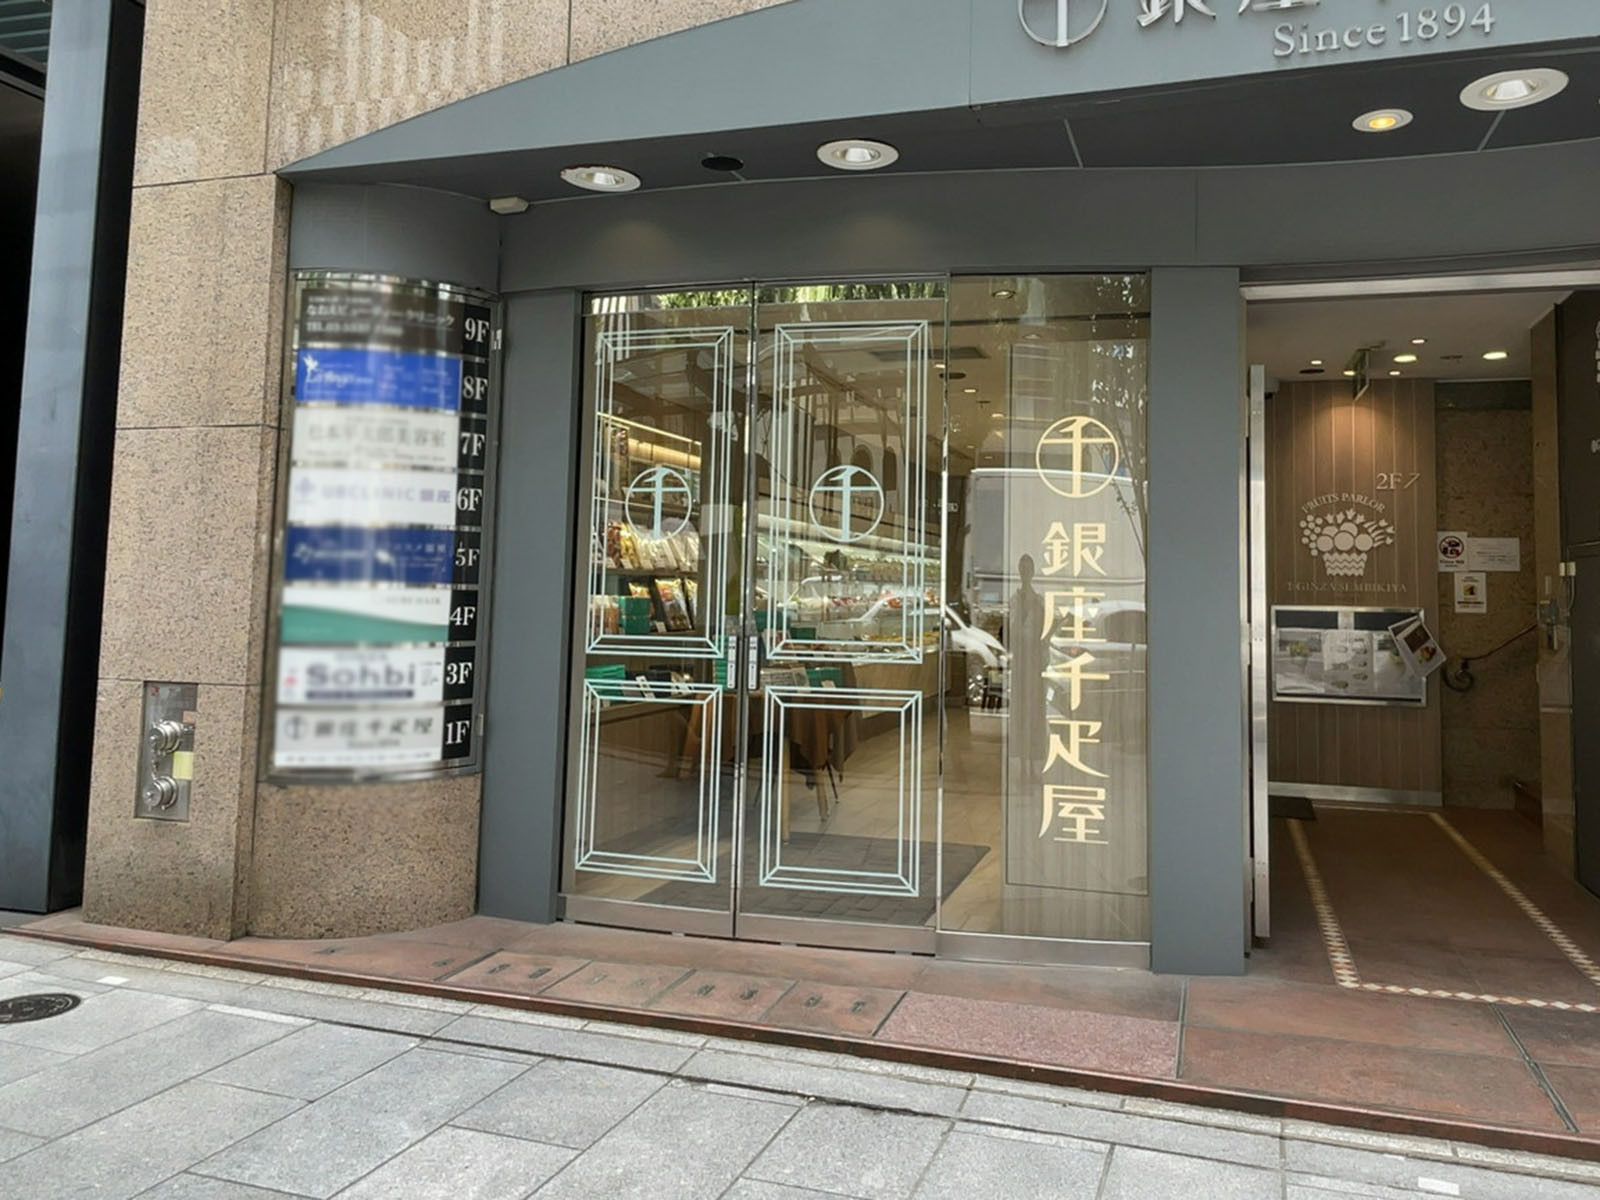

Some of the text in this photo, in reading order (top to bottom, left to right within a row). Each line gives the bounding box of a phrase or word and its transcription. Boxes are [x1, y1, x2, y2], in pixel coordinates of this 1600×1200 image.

[1273, 2, 1495, 58] Since 1894
[464, 317, 490, 342] 9F
[463, 376, 488, 400] 8F
[461, 432, 486, 456] 7F
[1376, 472, 1402, 490] 2F
[457, 488, 483, 512] 6F
[1302, 493, 1386, 513] FRUITS PARLOR
[455, 547, 480, 567] 5F
[450, 606, 476, 625] 4F
[305, 662, 416, 685] Sohbi
[446, 662, 472, 685] 3F
[1039, 521, 1110, 845] 銀座千疋屋
[445, 720, 470, 745] 1F
